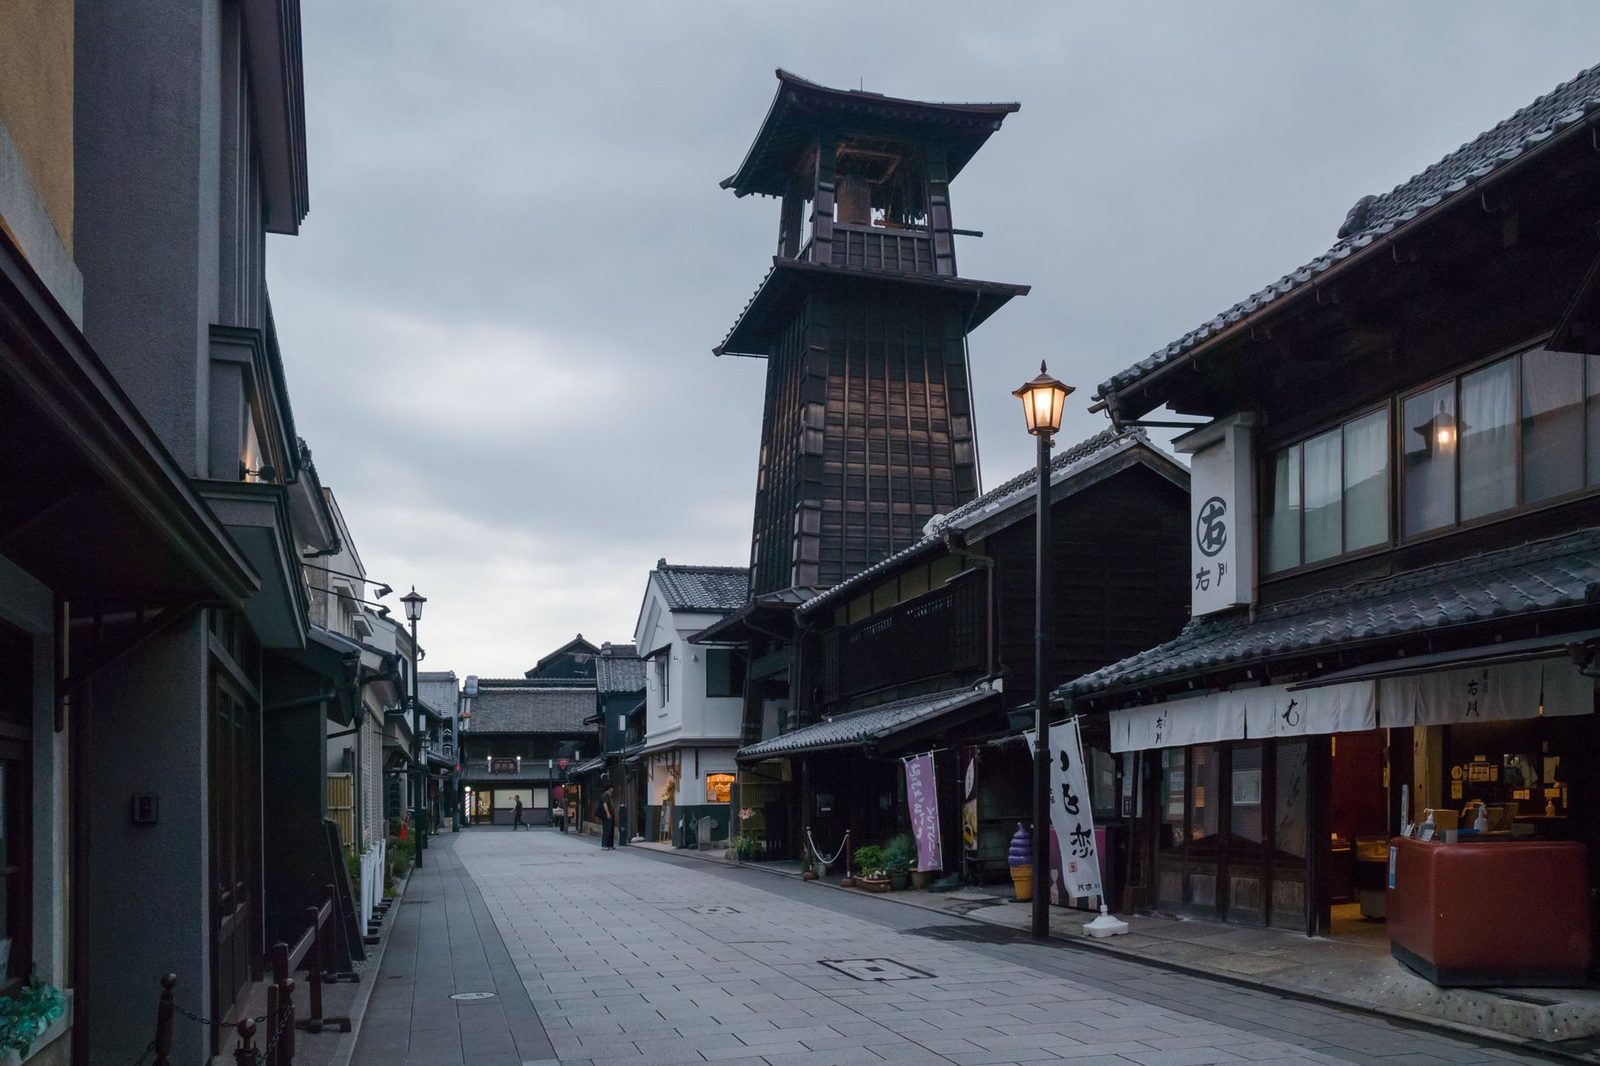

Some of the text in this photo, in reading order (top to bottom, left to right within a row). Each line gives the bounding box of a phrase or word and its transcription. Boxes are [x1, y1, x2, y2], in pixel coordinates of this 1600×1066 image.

[1200, 502, 1227, 551] 右
[1195, 561, 1228, 591] 右門
[1465, 678, 1480, 717] 右門
